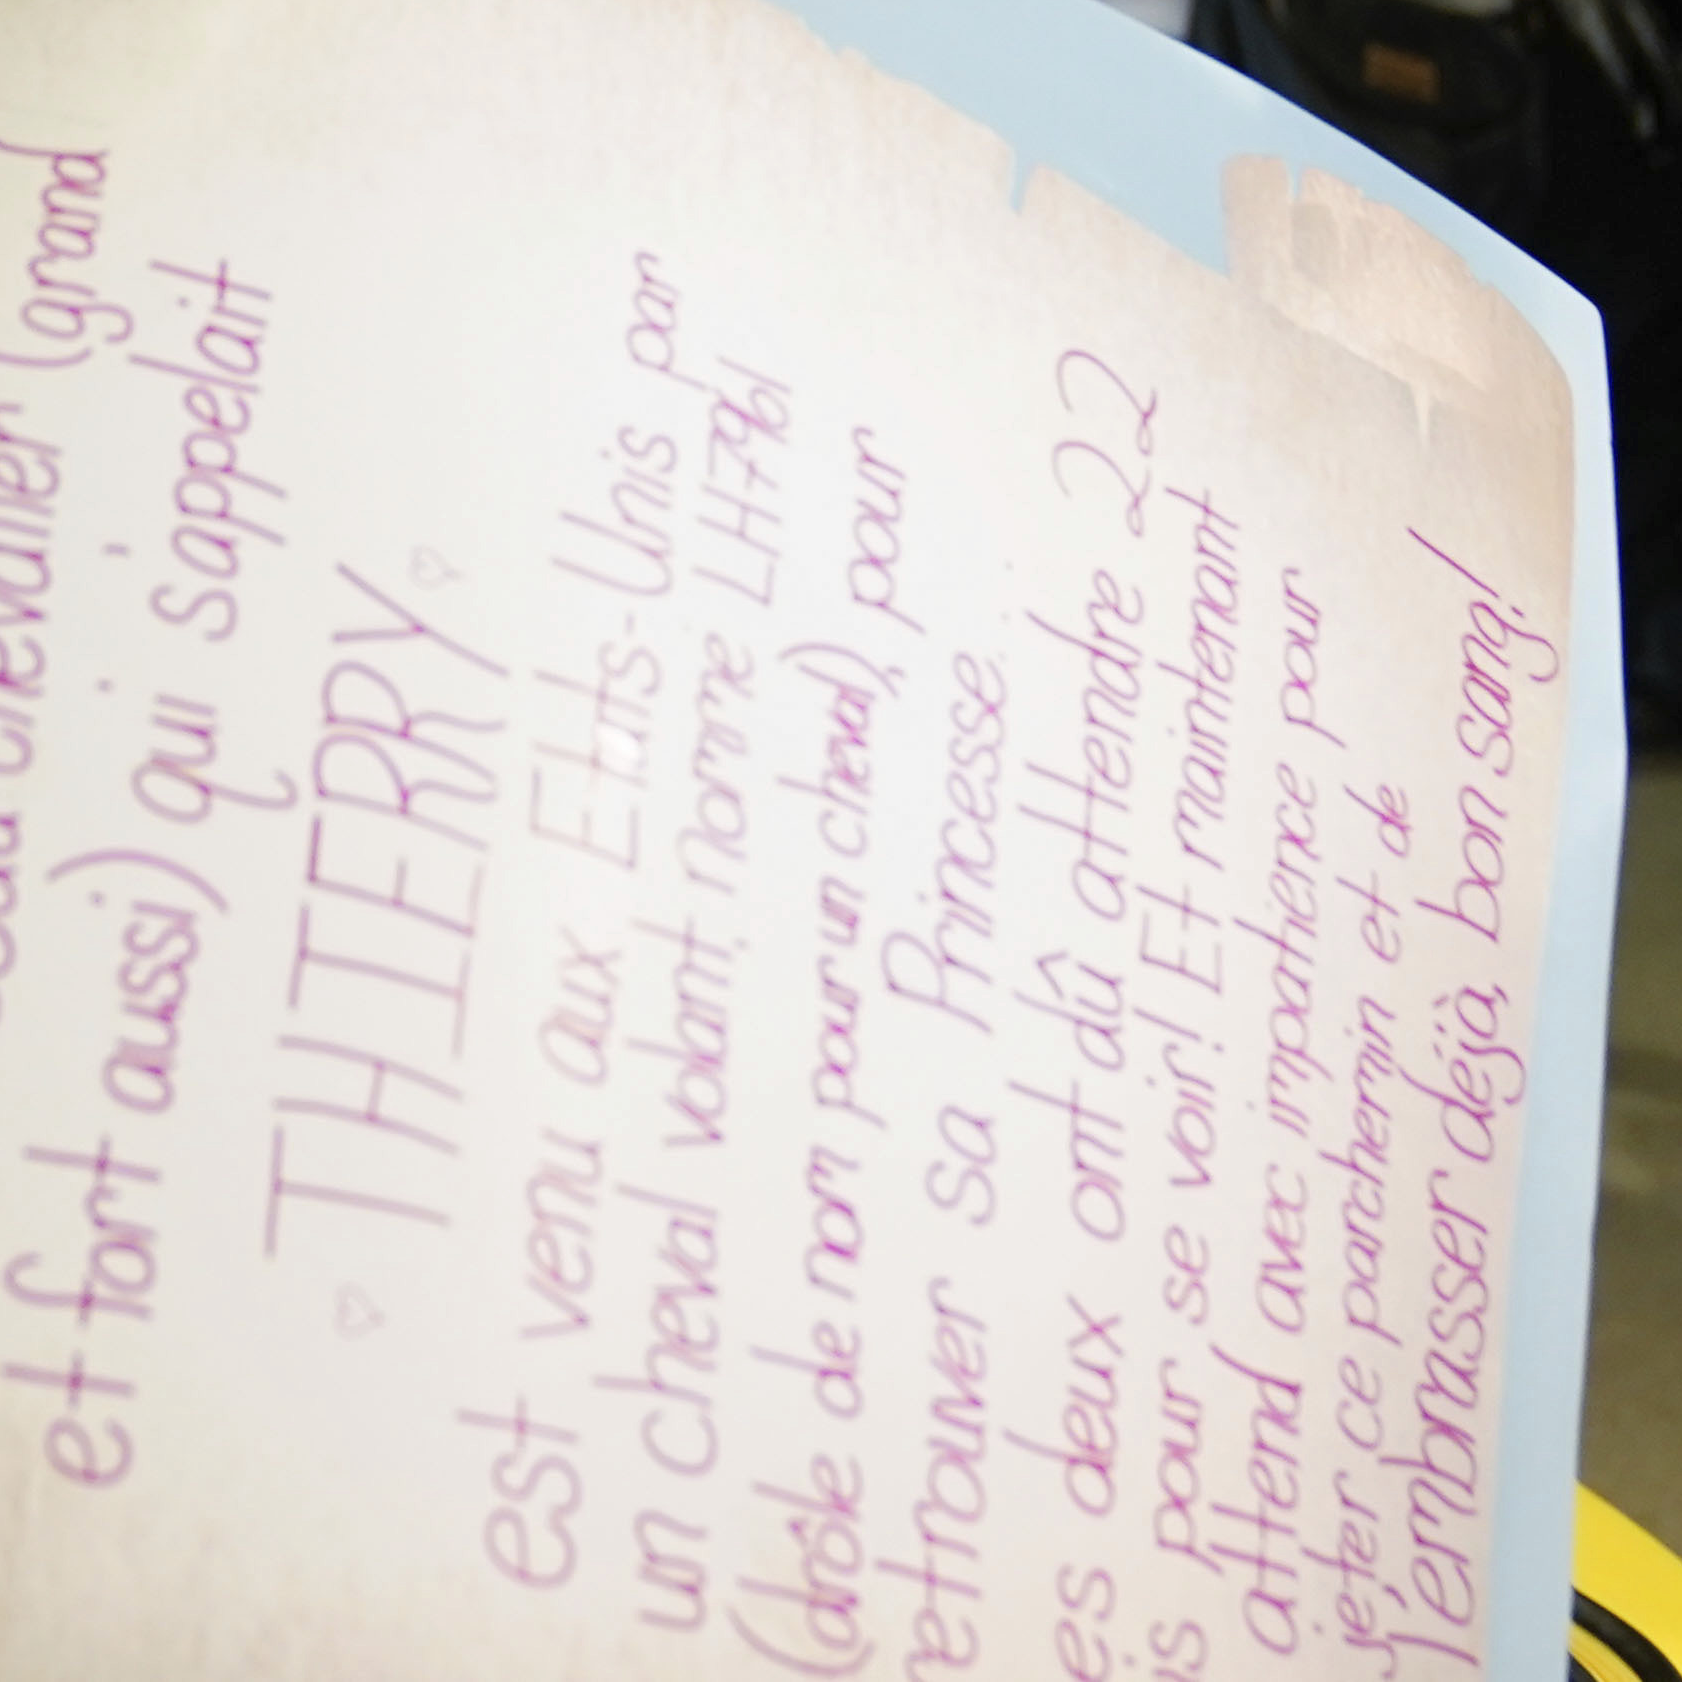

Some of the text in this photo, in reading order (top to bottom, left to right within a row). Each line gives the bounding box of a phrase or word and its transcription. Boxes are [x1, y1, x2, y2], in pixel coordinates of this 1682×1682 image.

[623, 250, 709, 394] par
[846, 426, 926, 636] pour
[1050, 348, 1158, 538] 22
[1018, 567, 1144, 923] attendre
[1154, 486, 1240, 872] maintenant
[1406, 527, 1560, 777] sang!
[94, 678, 297, 823] qui
[261, 561, 509, 1259] THIERRY
[818, 874, 867, 947] un
[1135, 882, 1222, 995] Et
[1414, 784, 1507, 943] bon
[43, 847, 227, 1115] aussi)
[535, 925, 621, 1088] aux
[808, 953, 888, 1131] pour
[1012, 950, 1125, 1072] dû
[925, 1103, 997, 1227] sa
[1006, 1080, 1124, 1243] ont
[1132, 1005, 1224, 1187] voir!
[1208, 566, 1347, 1656] attend avec impatience pour
[2, 1134, 162, 1329] fort
[518, 1125, 604, 1341] venu
[802, 1143, 863, 1301] nom
[1160, 1224, 1209, 1326] se
[1301, 783, 1410, 1681] jeter ce parchemin et de
[588, 1179, 721, 1478] cheval
[747, 1319, 864, 1421] de
[1002, 1293, 1123, 1518] deux
[454, 1394, 582, 1590] est
[1151, 1357, 1224, 1575] pour
[631, 1506, 709, 1634] un
